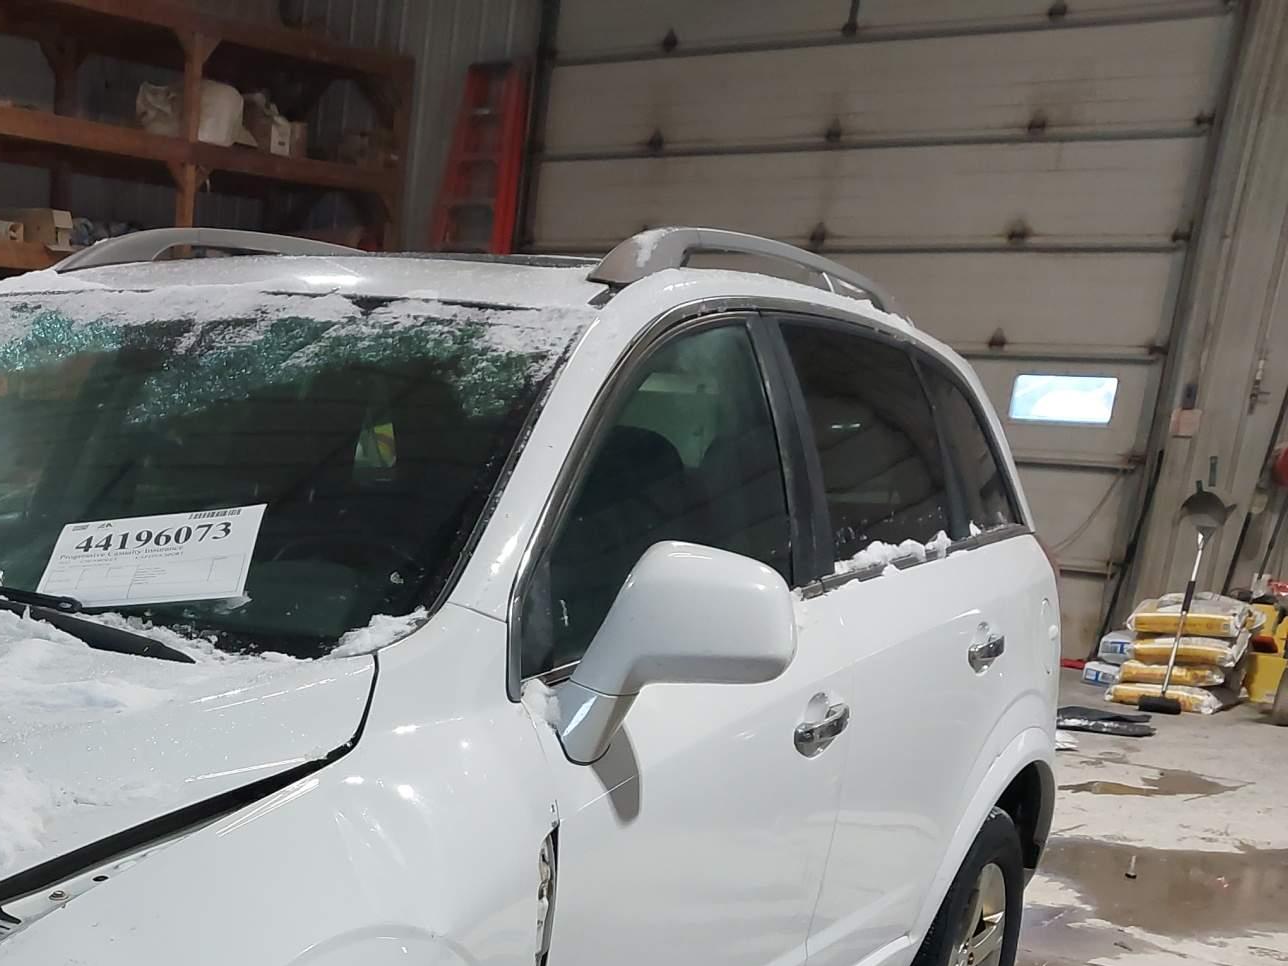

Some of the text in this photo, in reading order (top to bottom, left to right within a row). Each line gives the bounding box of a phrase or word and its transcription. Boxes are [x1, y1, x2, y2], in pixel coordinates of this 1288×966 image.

[75, 521, 232, 552] 44196073
[60, 552, 105, 561] Progressive
[108, 548, 142, 557] Casualty
[144, 545, 184, 554] Insurance
